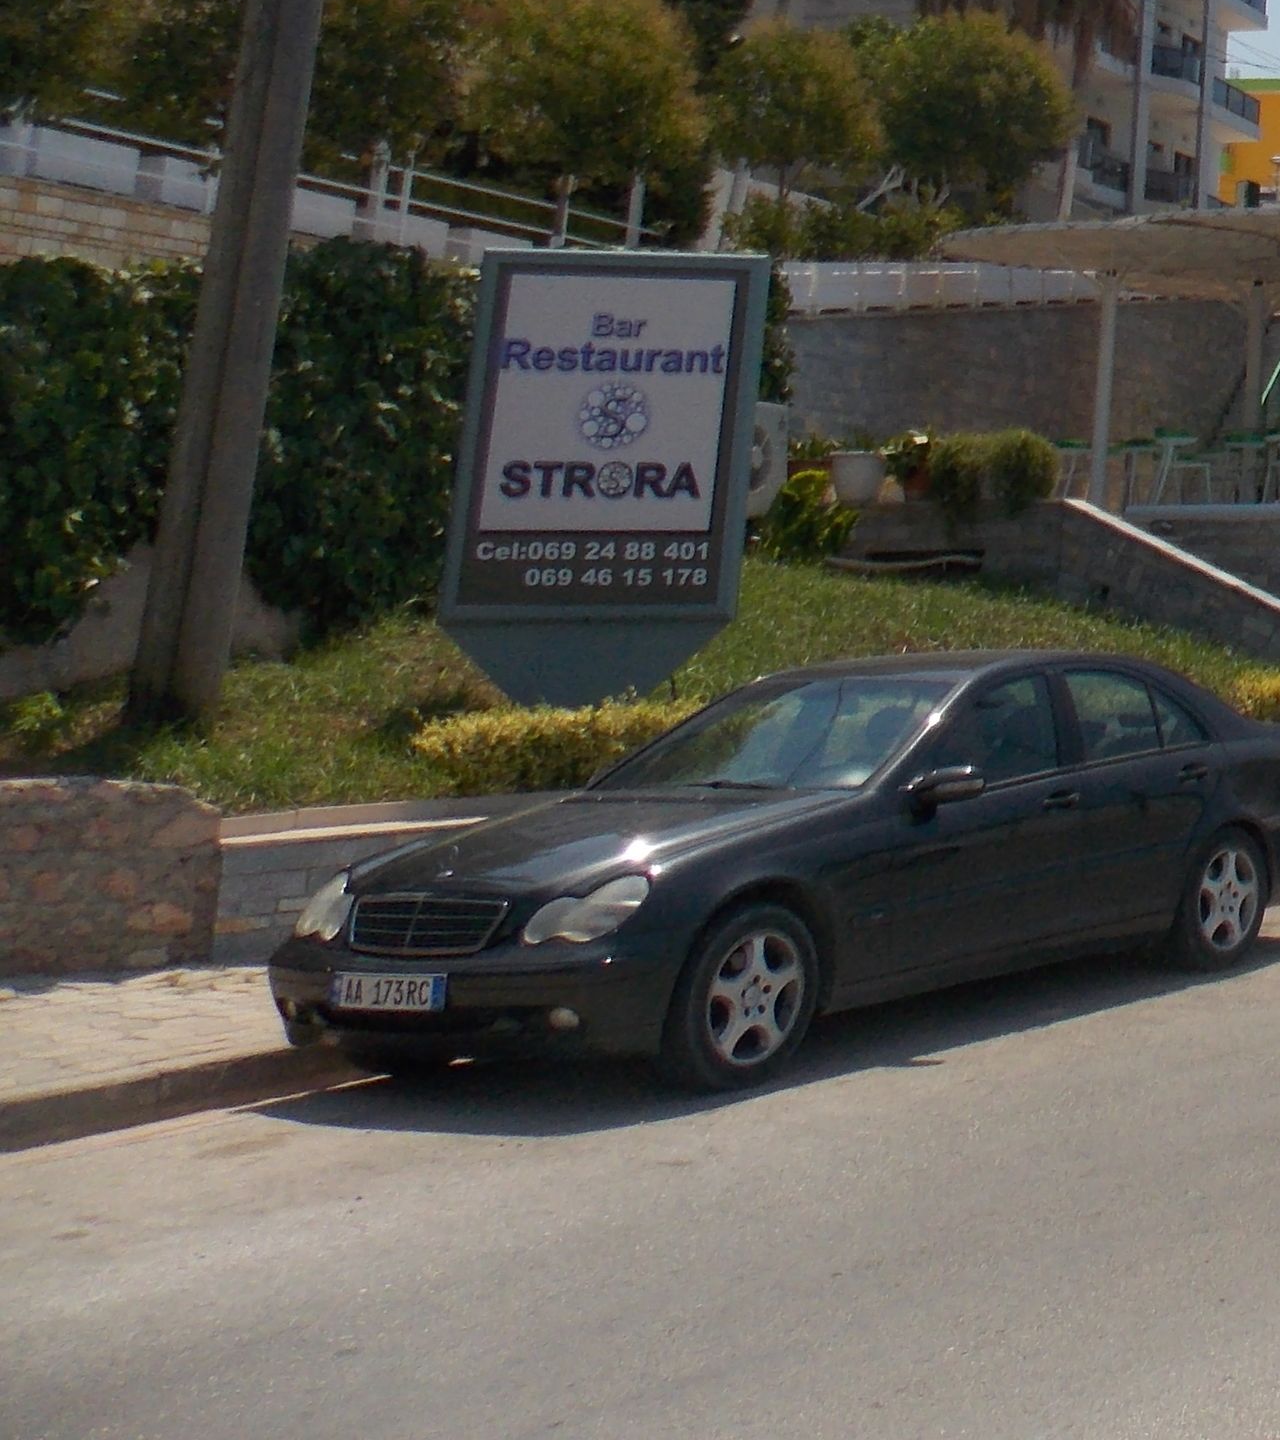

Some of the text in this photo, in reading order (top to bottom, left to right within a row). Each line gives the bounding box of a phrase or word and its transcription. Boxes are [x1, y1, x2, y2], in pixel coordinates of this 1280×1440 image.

[592, 312, 648, 337] Bar
[502, 338, 726, 374] Restaurant
[499, 461, 701, 500] STRORA
[584, 541, 616, 560] 24
[624, 541, 656, 561] 88
[663, 541, 710, 561] 401
[525, 568, 708, 586] 069 46 15 178
[344, 978, 431, 1006] AA 173RC
